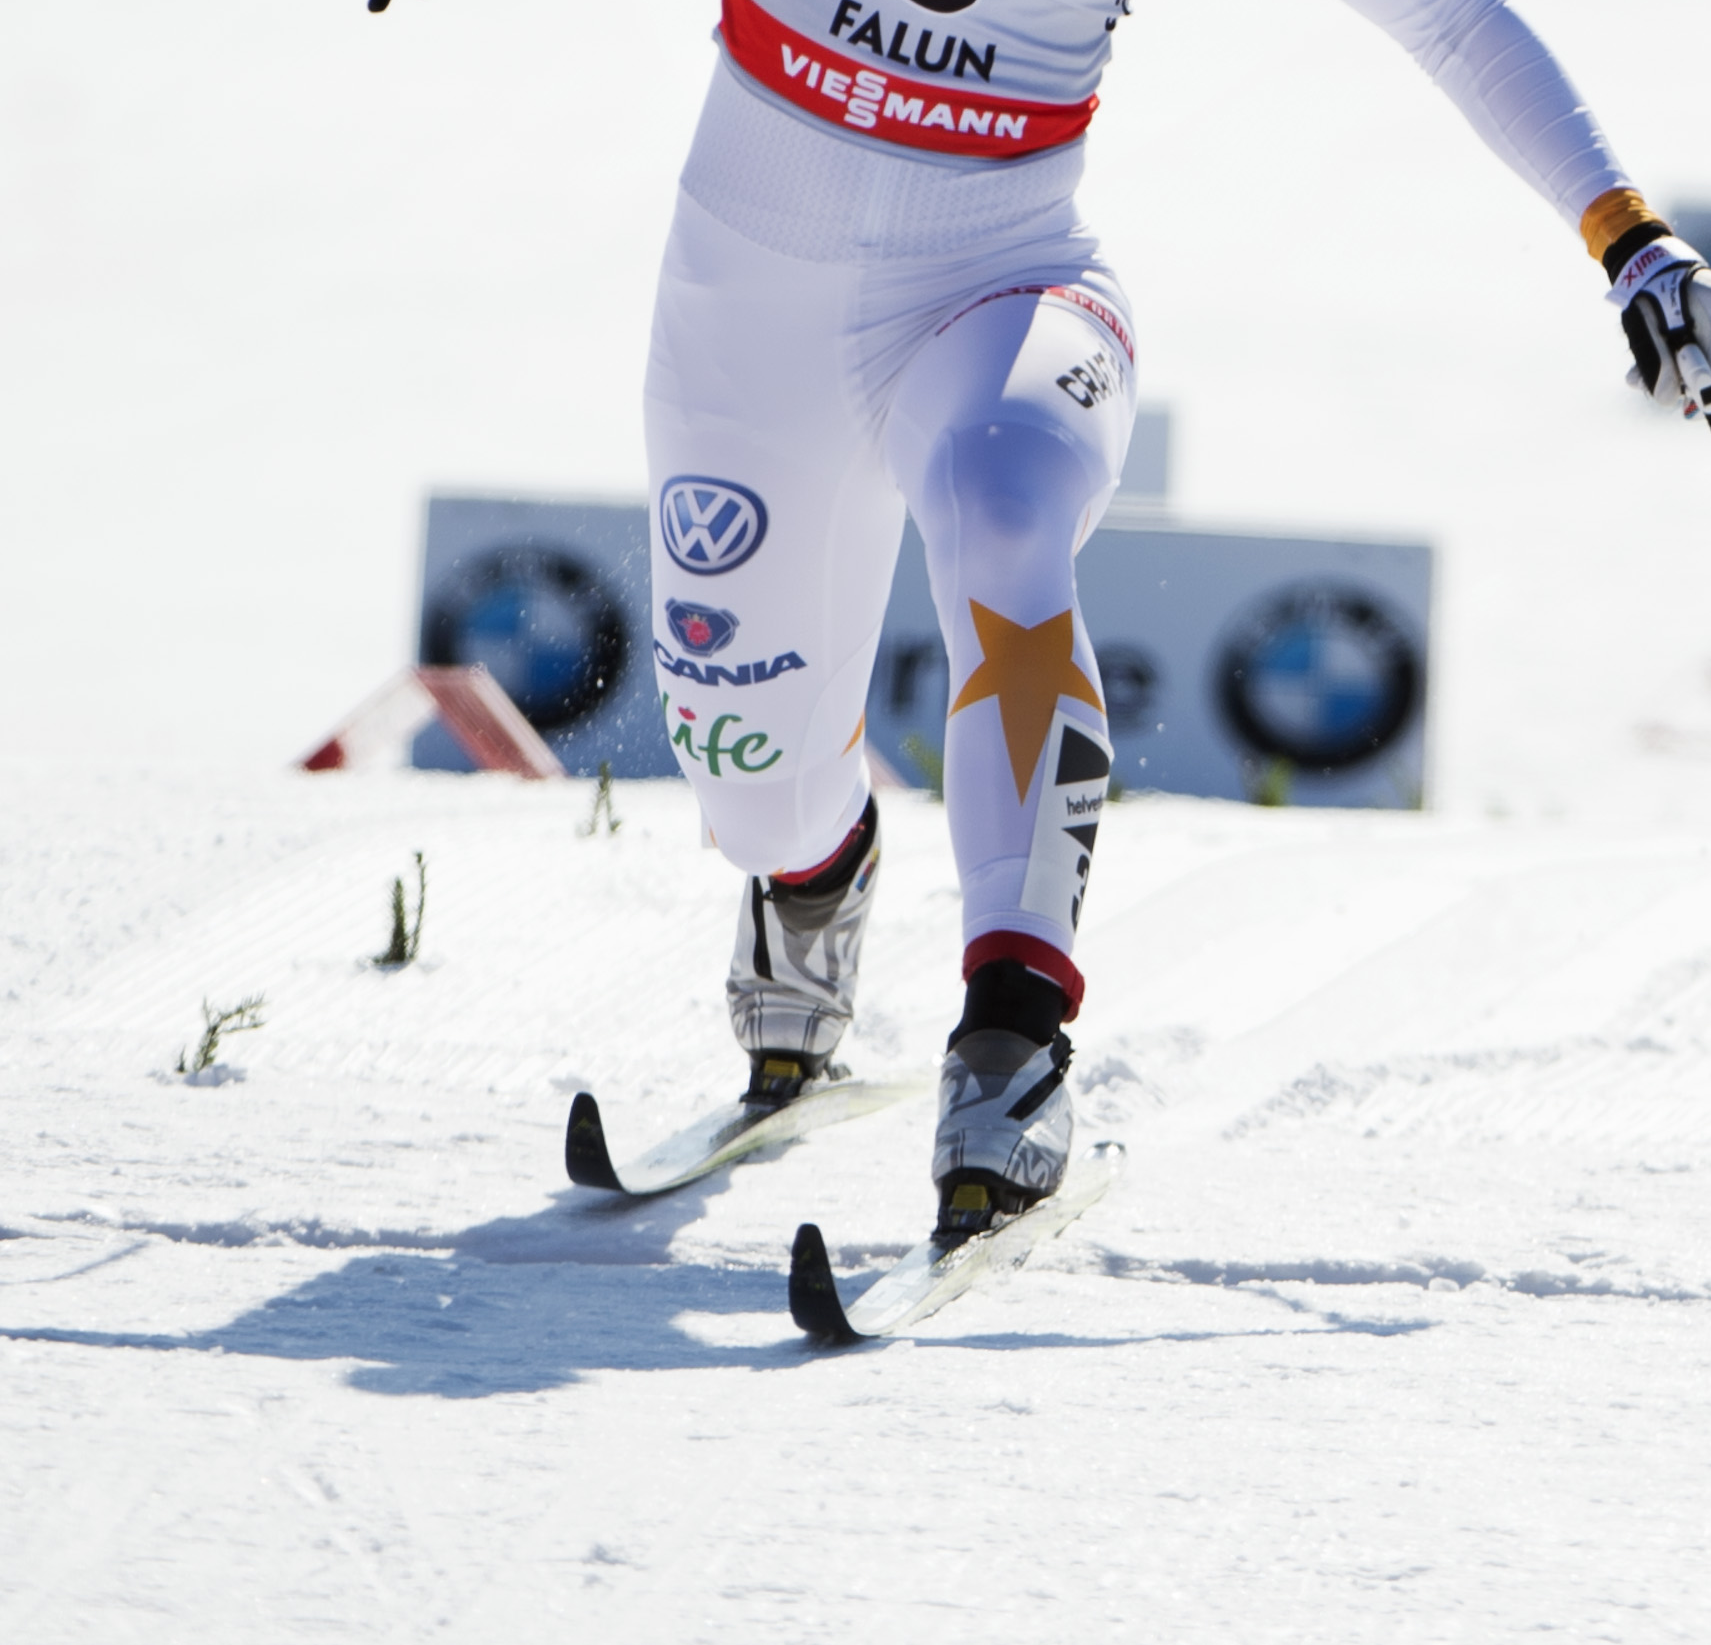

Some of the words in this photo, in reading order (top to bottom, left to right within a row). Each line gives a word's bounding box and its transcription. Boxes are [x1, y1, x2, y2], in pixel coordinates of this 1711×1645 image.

[780, 43, 1028, 140] VIESSMANN
[653, 638, 808, 687] CANIA
[661, 690, 784, 778] ife
